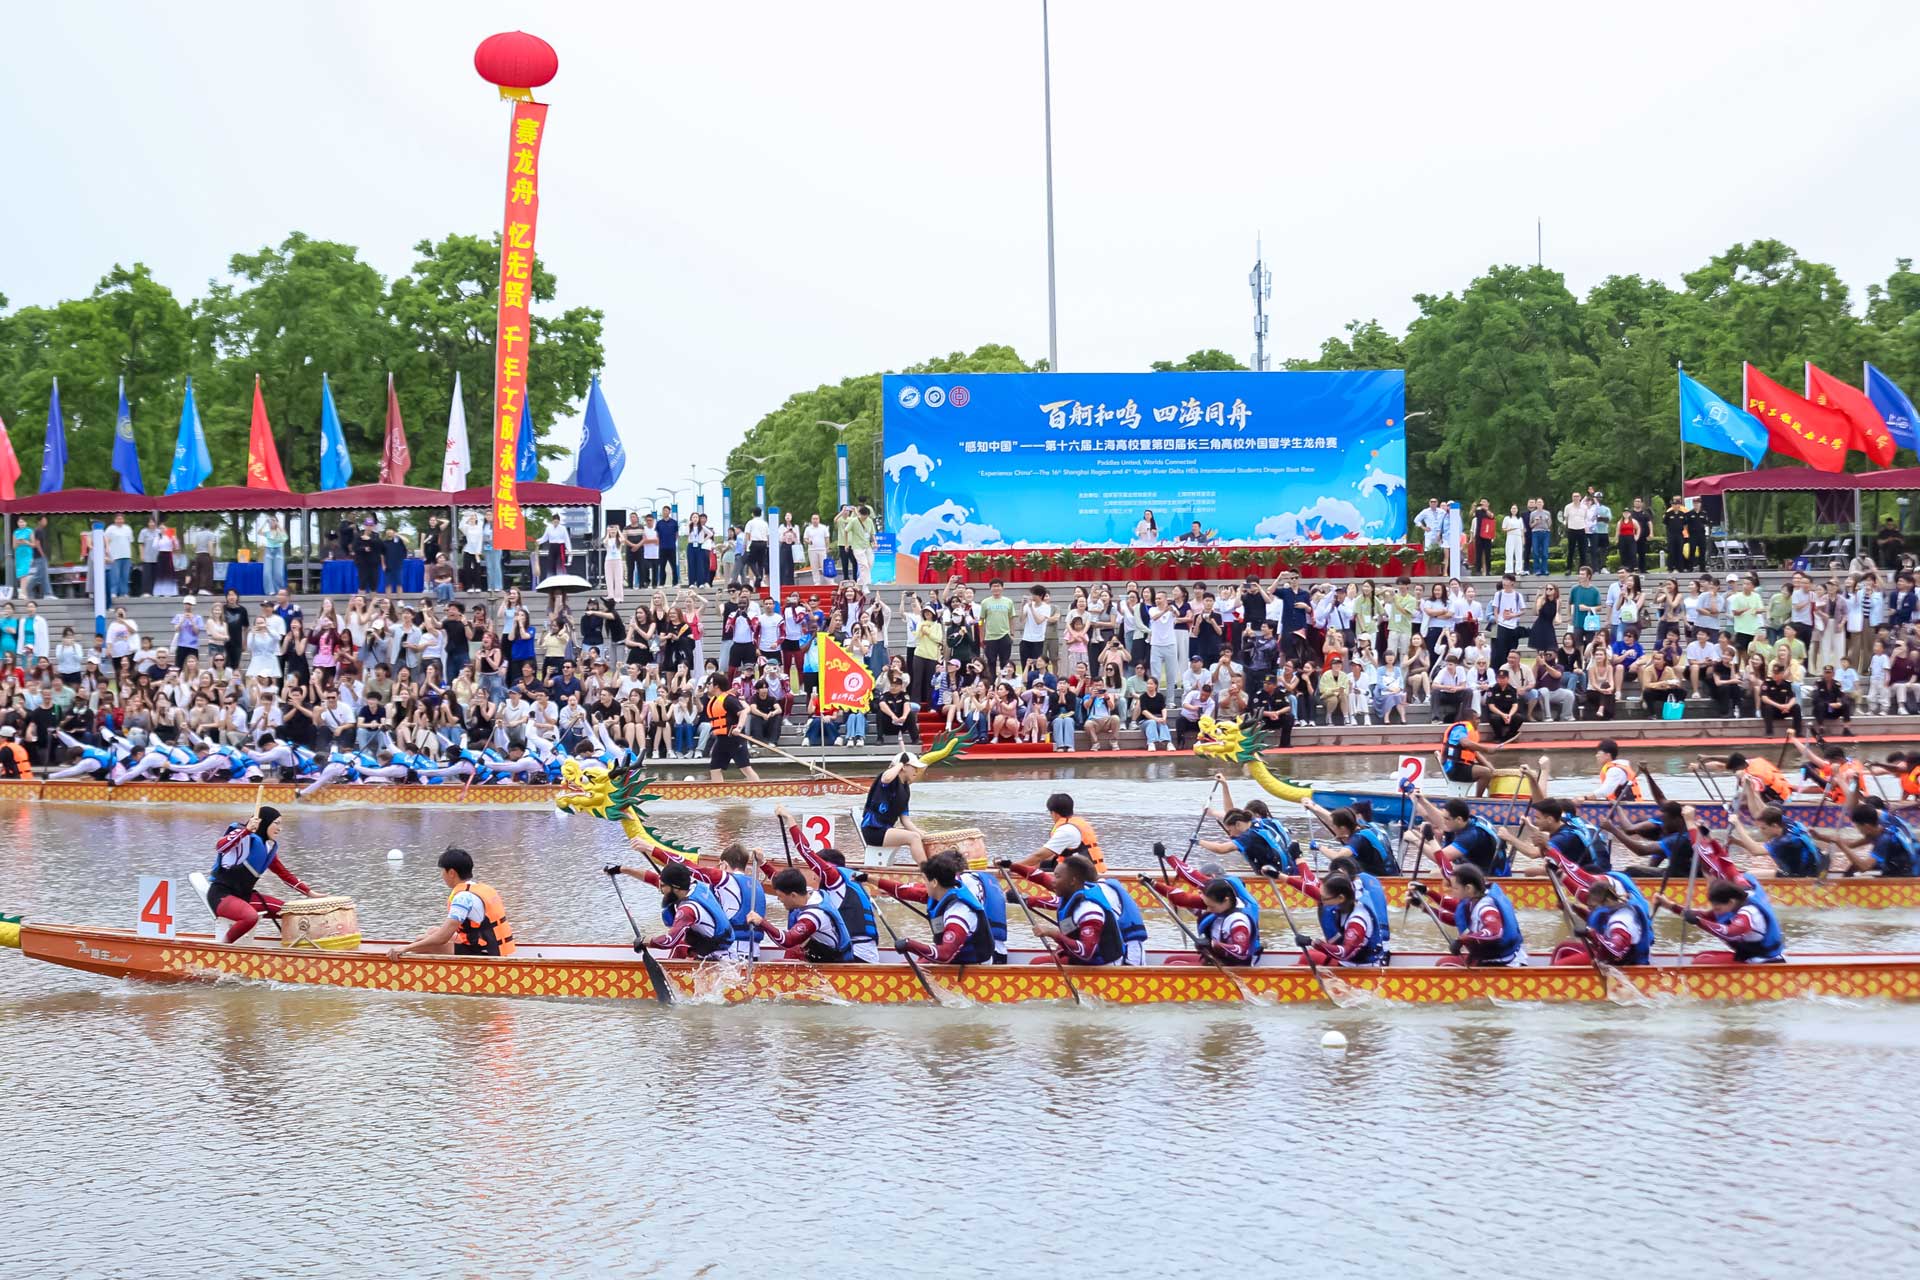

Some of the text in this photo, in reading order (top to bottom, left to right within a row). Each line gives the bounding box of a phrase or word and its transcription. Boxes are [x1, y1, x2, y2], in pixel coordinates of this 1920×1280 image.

[511, 118, 540, 206] 赛龙舟
[504, 221, 532, 309] 忆先贤
[1038, 397, 1252, 431] 百舸和鸣 四海同舟
[1063, 469, 1089, 477] Shanghai
[1263, 466, 1285, 474] Dragon
[1398, 758, 1422, 792] 2
[806, 816, 832, 849] 3
[140, 880, 173, 934] 4
